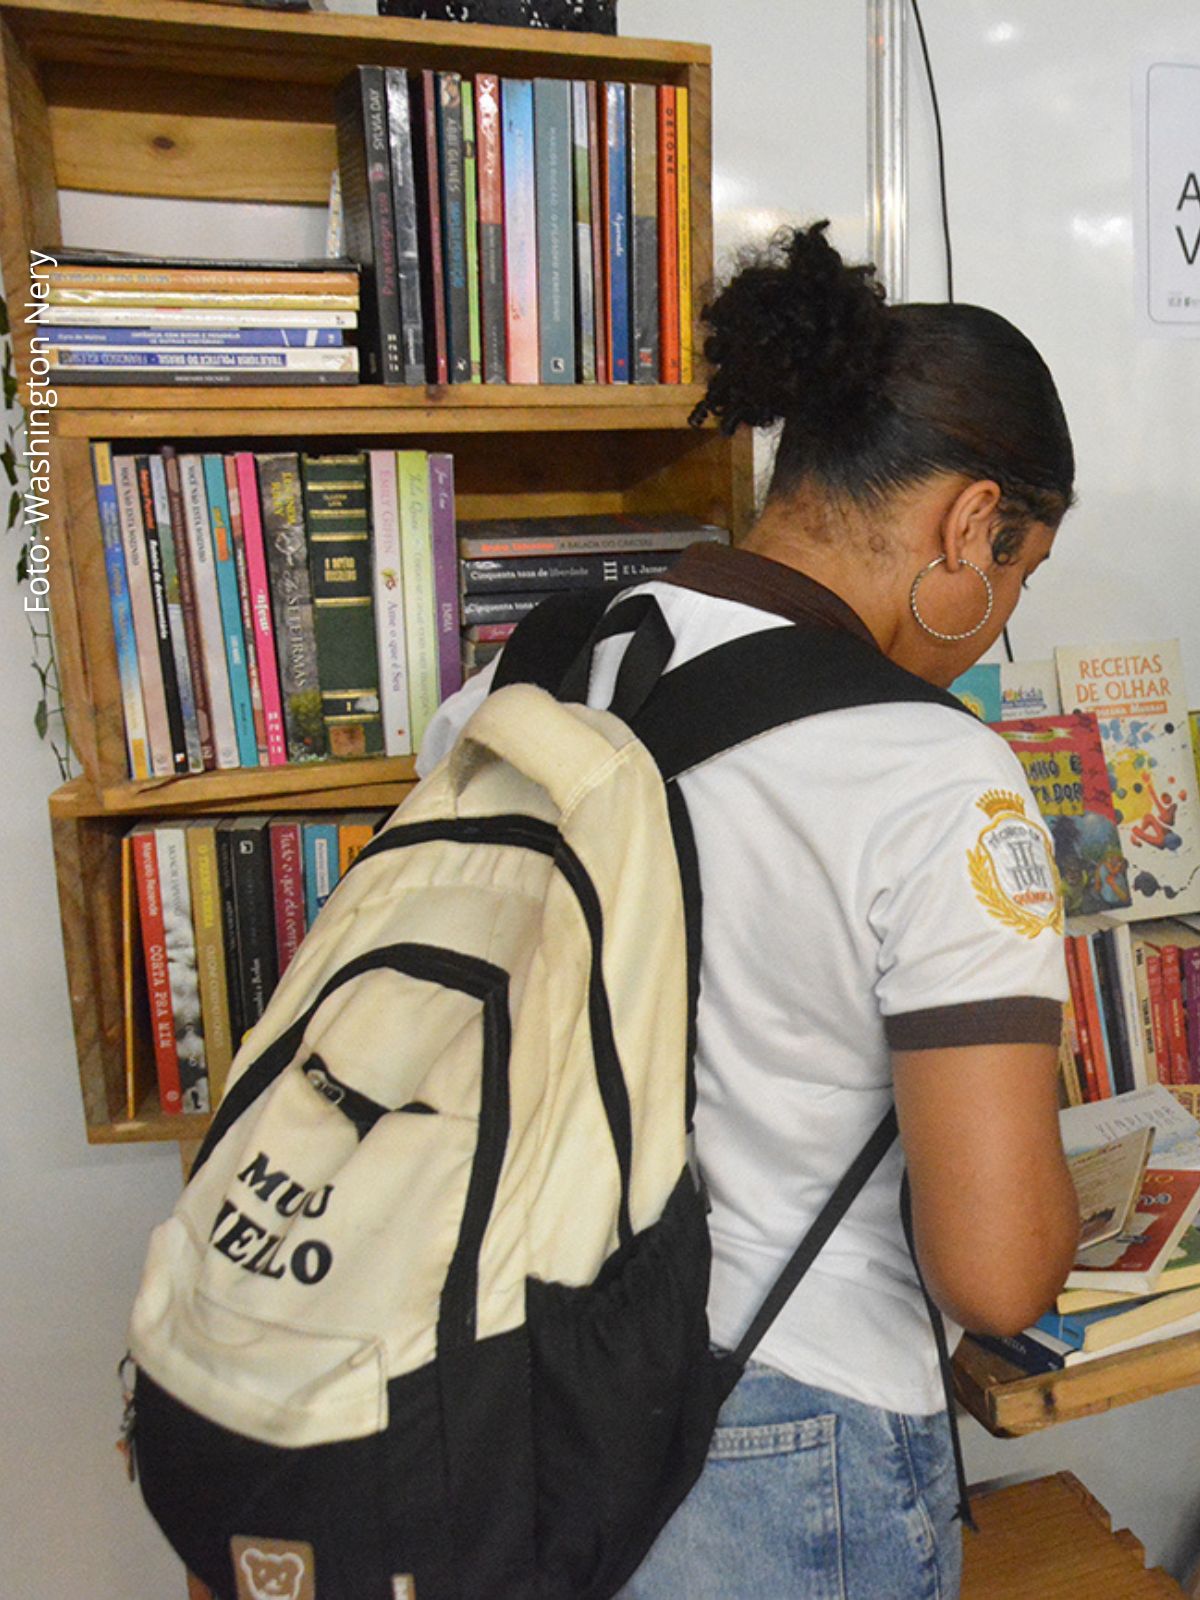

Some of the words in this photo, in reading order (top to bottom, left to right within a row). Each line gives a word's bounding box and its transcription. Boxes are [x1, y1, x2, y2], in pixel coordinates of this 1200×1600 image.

[368, 87, 383, 112] DAY
[369, 113, 386, 151] SYLVIA
[470, 570, 516, 582] Cinquenta
[1078, 653, 1163, 680] RECEITAS
[1074, 682, 1101, 704] DE
[1104, 677, 1172, 701] OLHAR
[142, 843, 155, 877] Marcelo
[146, 879, 159, 917] Rezende
[149, 944, 166, 987] CORTA
[154, 991, 170, 1018] PRA
